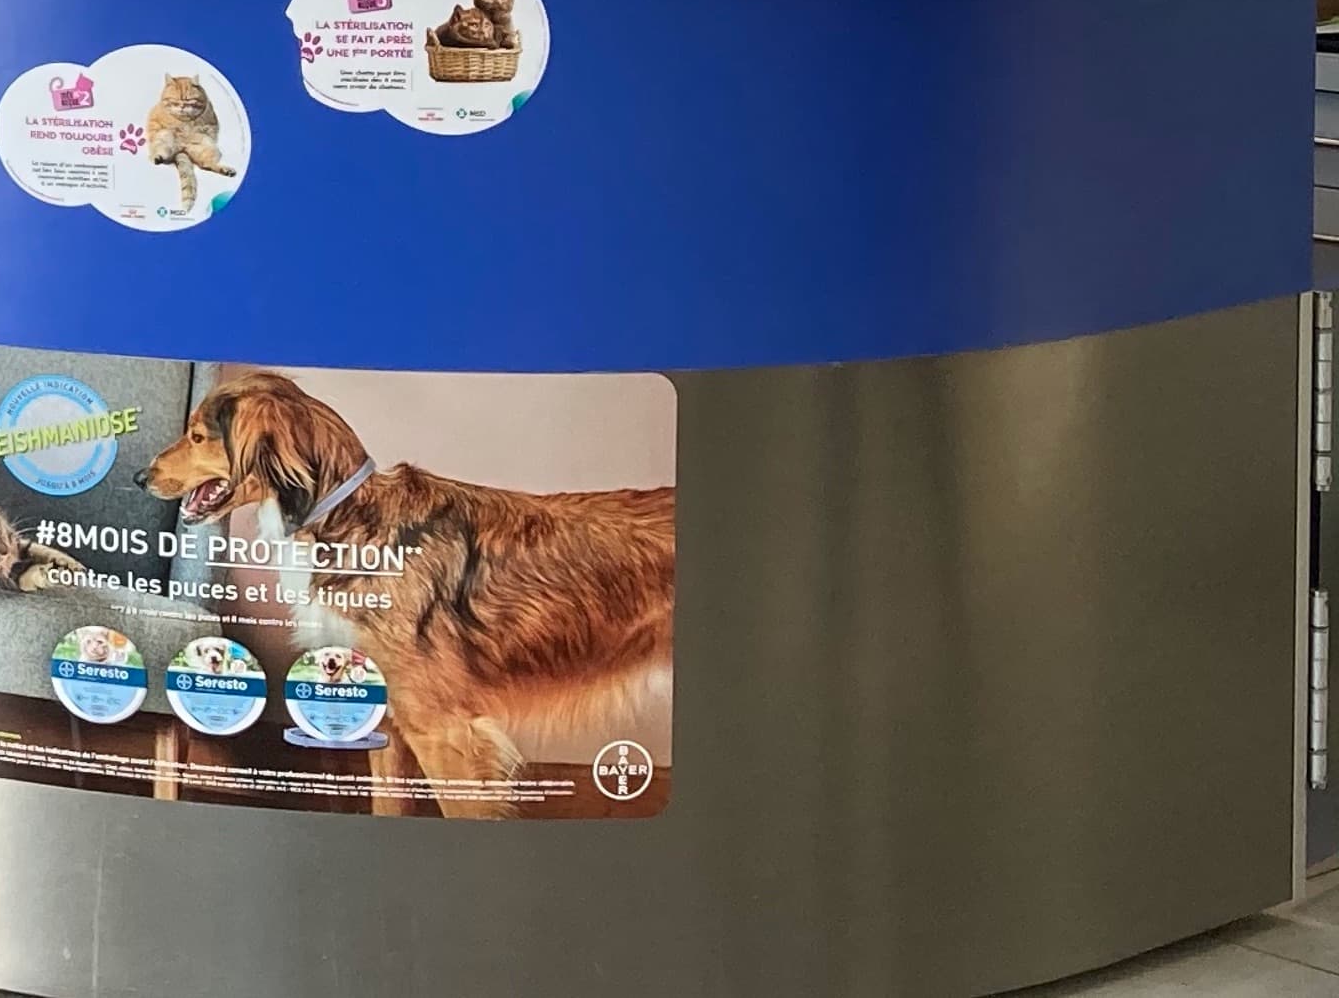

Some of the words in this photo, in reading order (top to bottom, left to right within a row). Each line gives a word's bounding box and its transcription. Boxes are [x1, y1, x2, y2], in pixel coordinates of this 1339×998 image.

[316, 20, 329, 30] LA
[334, 17, 414, 31] STÉRILISATION
[336, 34, 349, 44] SE
[351, 34, 374, 44] FAIT
[376, 33, 413, 45] APRÈS
[326, 48, 350, 58] UNE
[371, 46, 414, 59] PORTÉE
[25, 117, 39, 127] LA
[42, 114, 114, 129] STÉRILISATION
[30, 130, 57, 140] REND
[60, 131, 114, 143] TOUJOURS
[82, 143, 115, 156] OBÈSE
[6, 383, 41, 416] NOUVELLE
[43, 380, 94, 406] INDICATION
[35, 518, 150, 555] #8MOIS
[157, 531, 200, 560] DE
[47, 566, 122, 591] contre
[127, 570, 163, 596] les
[168, 578, 239, 604] puces
[245, 584, 269, 604] et
[275, 581, 312, 606] les
[316, 584, 394, 613] tiques
[76, 662, 129, 682] Seresto
[194, 675, 249, 692] Seresto
[314, 684, 369, 700] Seresto
[598, 764, 649, 777] BAYER
